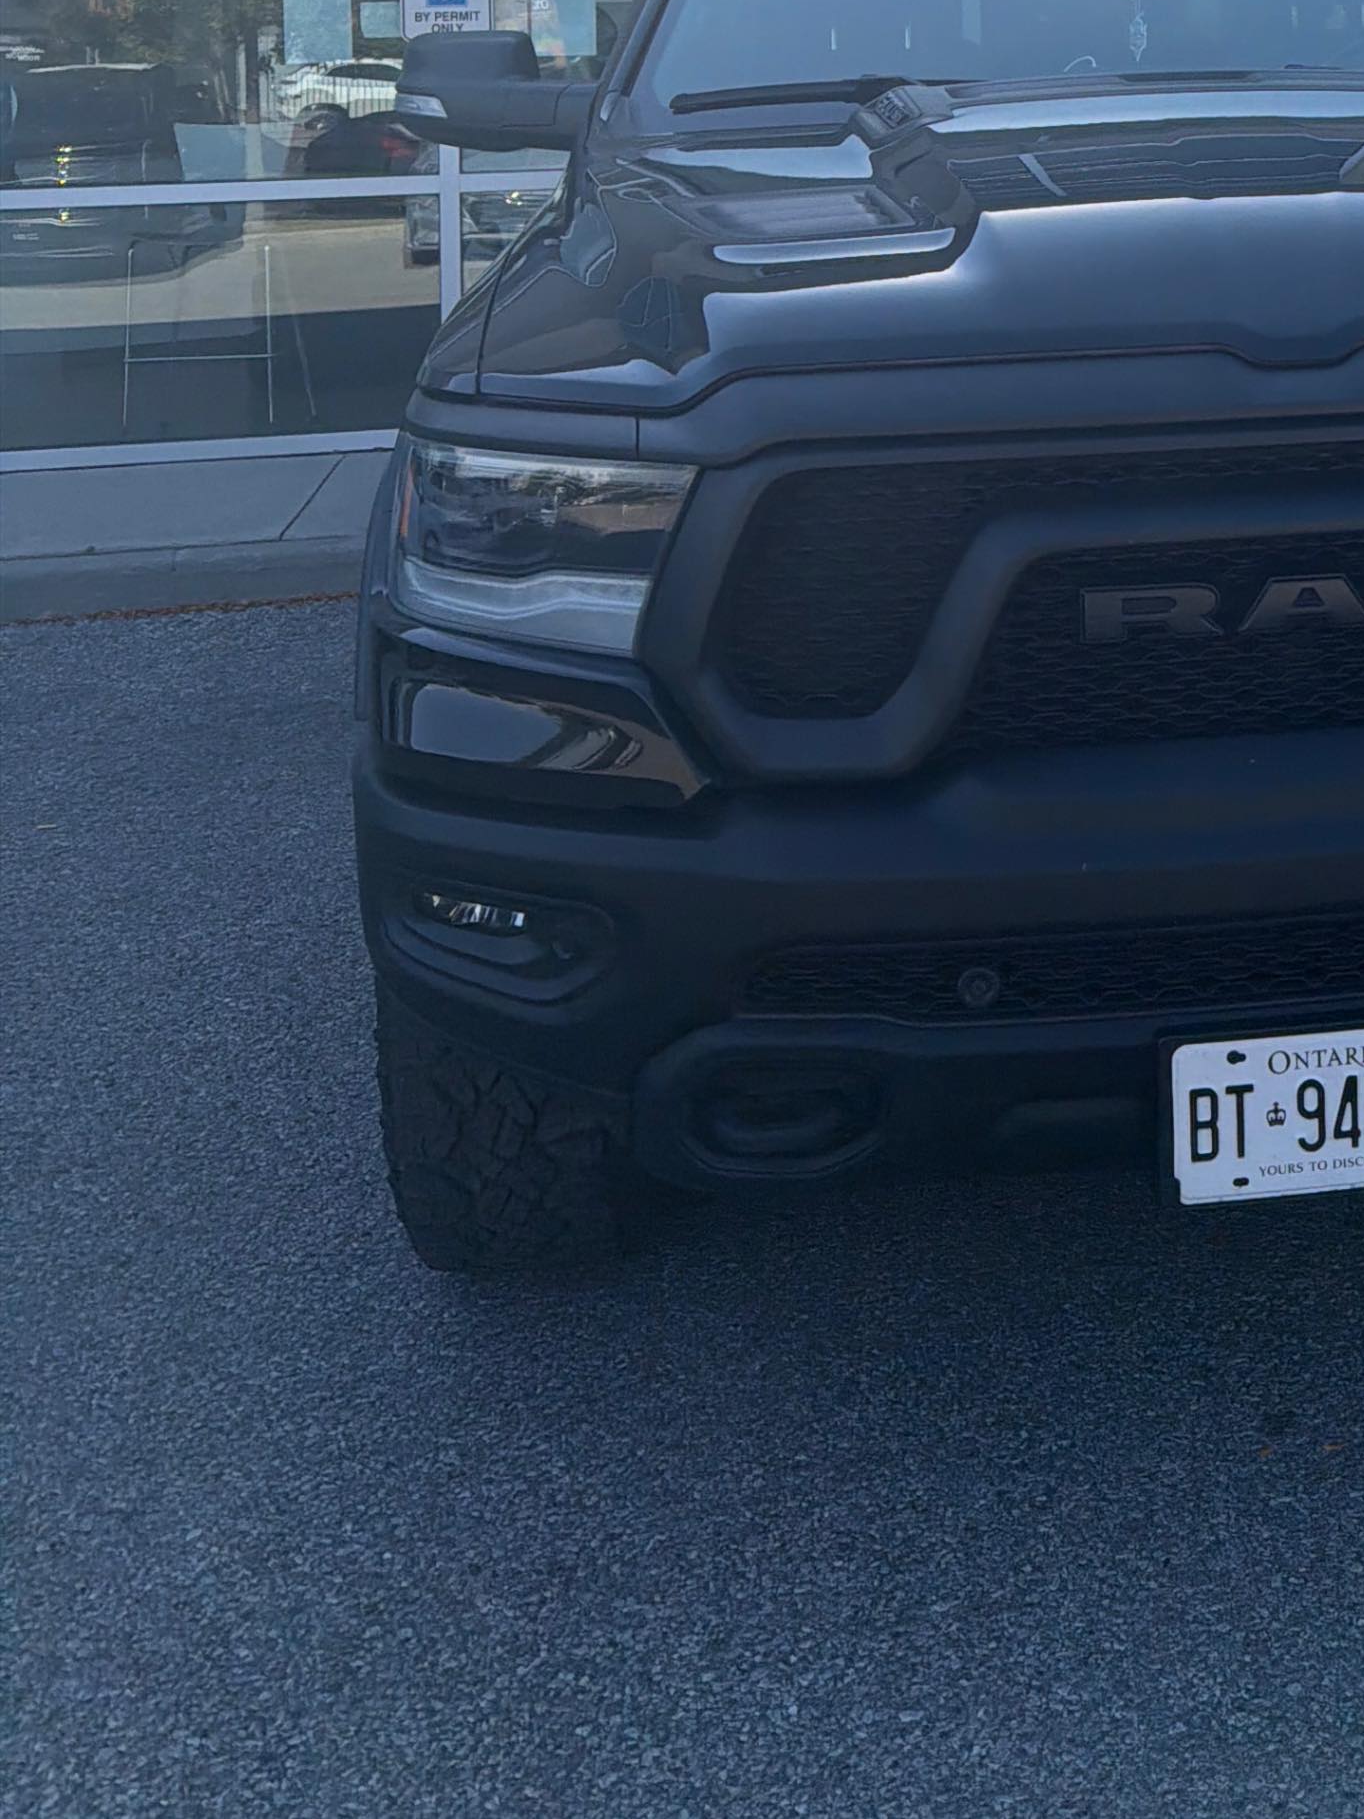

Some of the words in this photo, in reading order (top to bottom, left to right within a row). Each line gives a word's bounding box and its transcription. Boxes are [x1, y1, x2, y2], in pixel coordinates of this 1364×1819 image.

[414, 11, 430, 22] BY
[434, 11, 481, 22] PERMIT
[1189, 1083, 1255, 1163] BT
[1258, 1161, 1304, 1178] YOURS
[1310, 1160, 1328, 1172] TO
